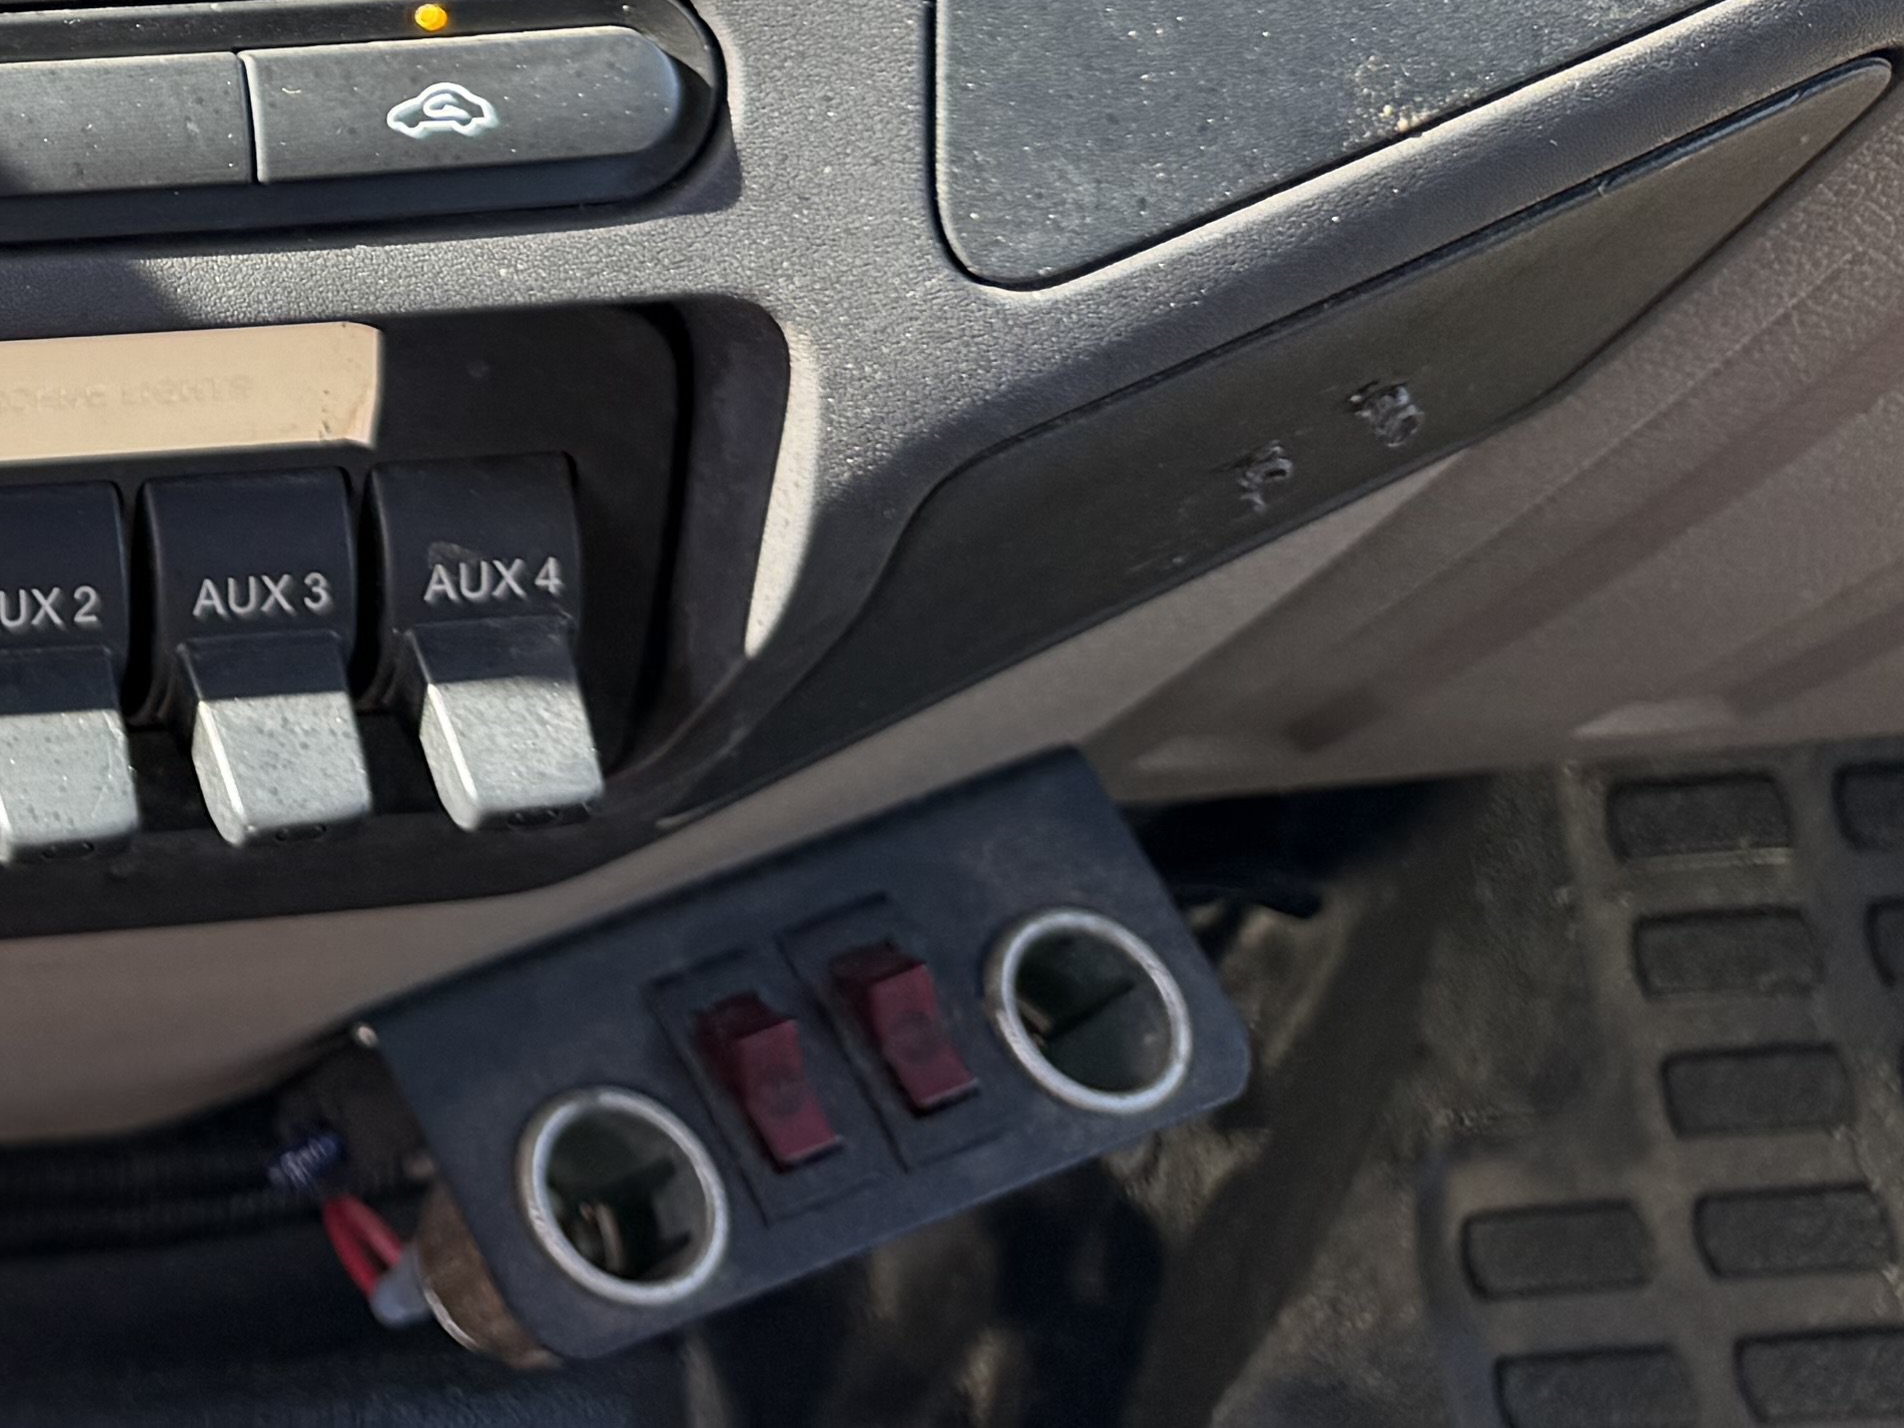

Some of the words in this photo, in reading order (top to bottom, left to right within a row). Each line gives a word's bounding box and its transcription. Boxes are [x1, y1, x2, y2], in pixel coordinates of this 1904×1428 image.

[193, 575, 293, 616] AUX
[304, 573, 330, 611] 3
[425, 559, 525, 601] AUX
[535, 557, 562, 594] 4
[74, 586, 98, 624] 2
